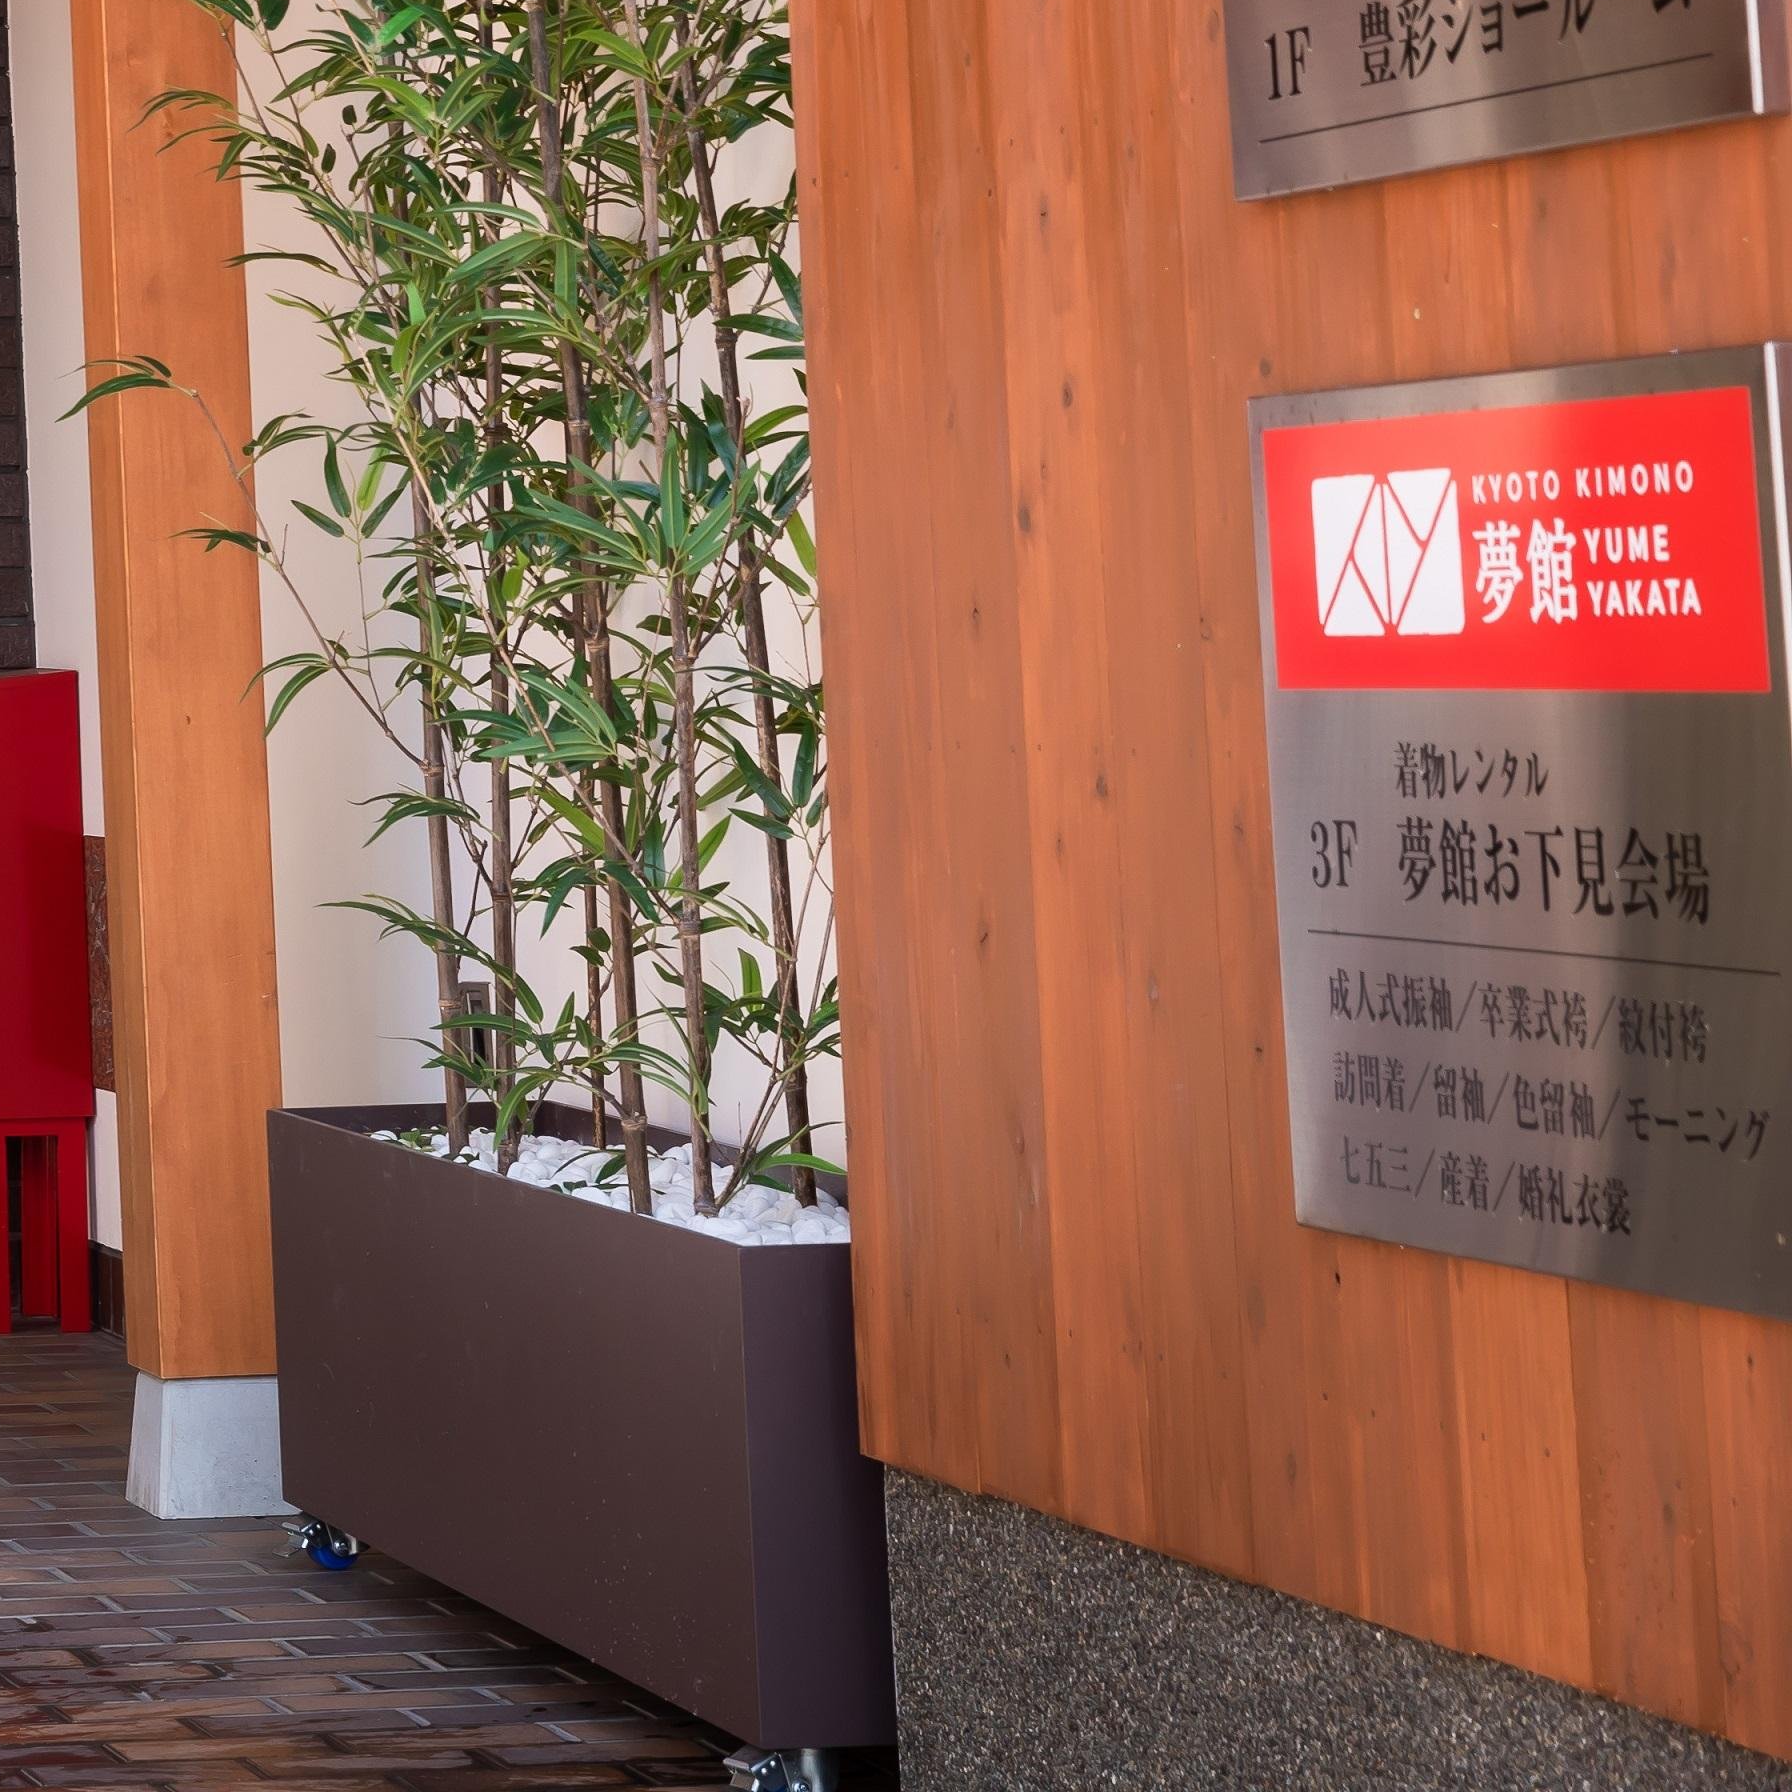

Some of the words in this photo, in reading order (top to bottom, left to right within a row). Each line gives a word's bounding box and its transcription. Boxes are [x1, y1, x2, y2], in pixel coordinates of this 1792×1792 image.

[1266, 26, 1312, 102] 1F
[1471, 468, 1561, 505] KYOTO
[1575, 459, 1696, 498] KIMONO
[1472, 517, 1578, 625] 夢館
[1582, 523, 1672, 565] YUME
[1585, 577, 1703, 618] YAKATA
[1392, 740, 1550, 800] 着物レンタル
[1310, 818, 1359, 889] 3F
[1396, 815, 1711, 926] 夢館お下見会場
